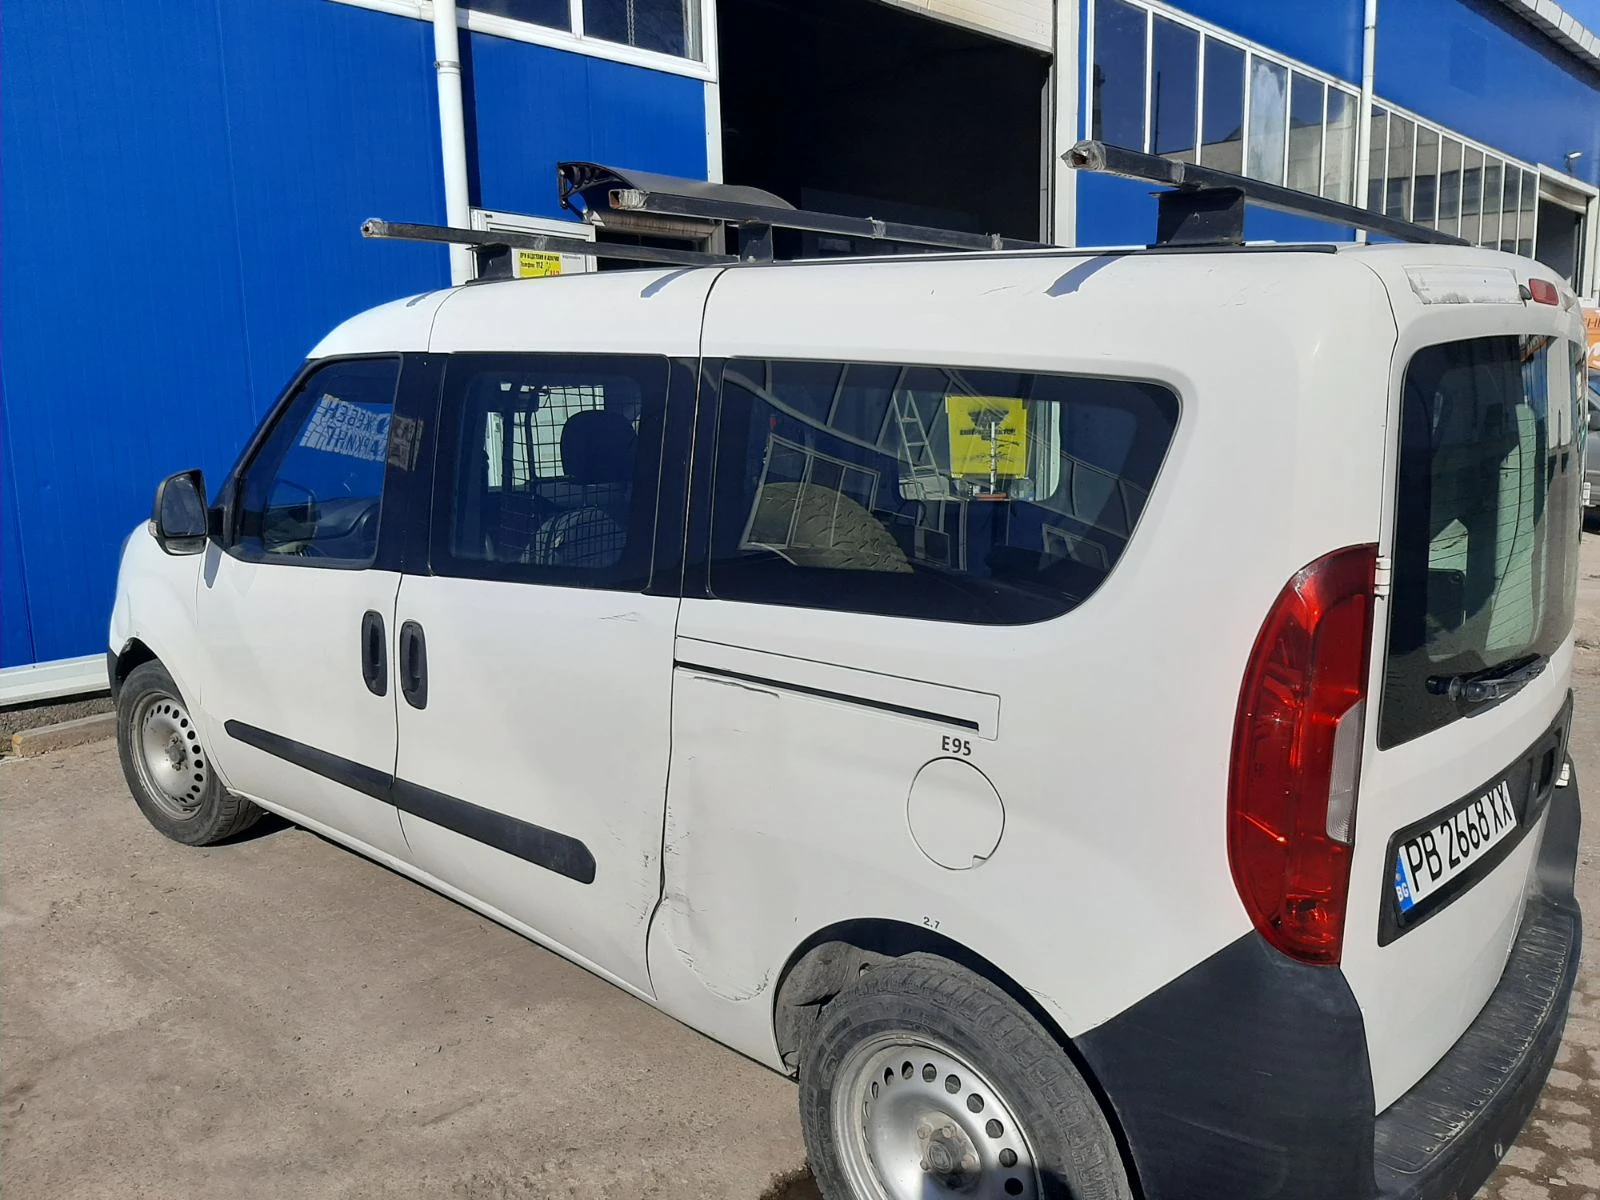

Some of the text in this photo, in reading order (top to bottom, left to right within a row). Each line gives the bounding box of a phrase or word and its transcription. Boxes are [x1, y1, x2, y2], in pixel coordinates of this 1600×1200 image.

[942, 735, 971, 756] E95
[1405, 783, 1512, 892] PB 2668 XX
[1395, 882, 1409, 901] BG
[923, 916, 940, 929] 2.7
